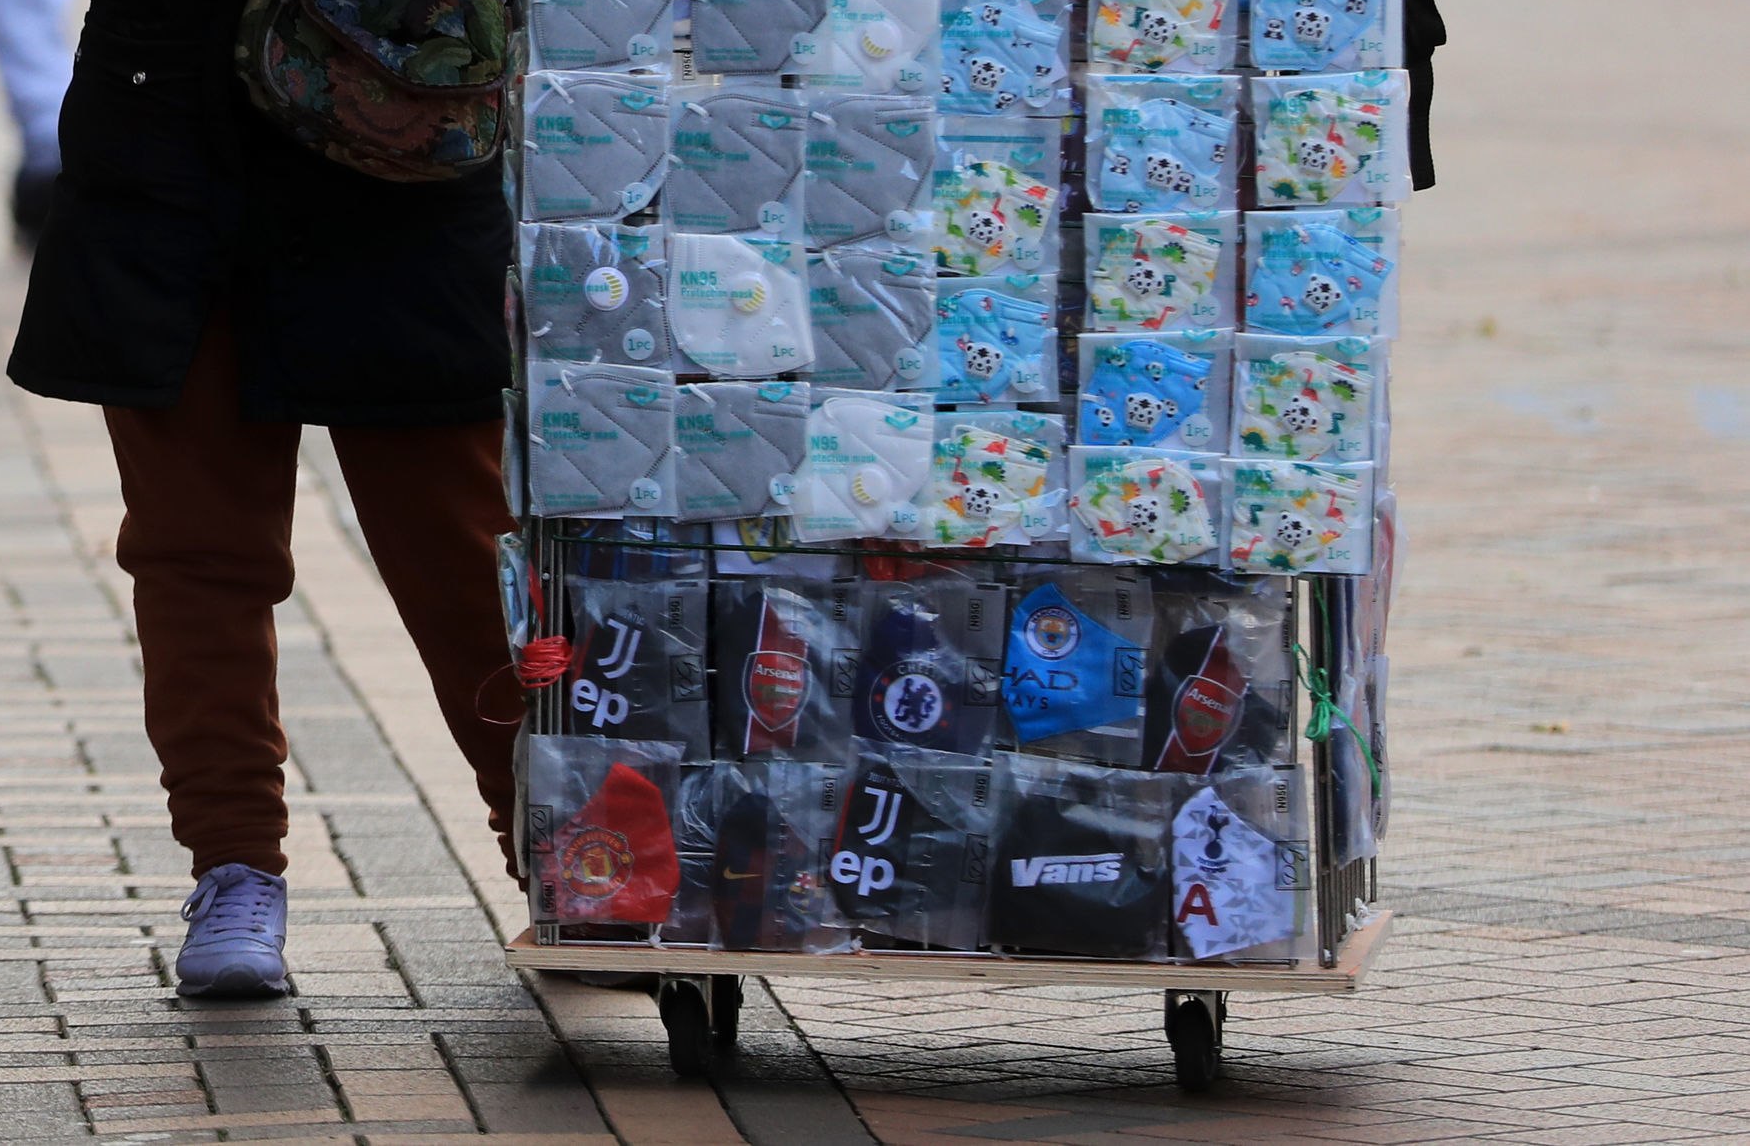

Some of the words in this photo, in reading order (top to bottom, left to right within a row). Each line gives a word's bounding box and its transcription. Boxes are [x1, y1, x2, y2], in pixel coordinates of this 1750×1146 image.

[536, 115, 574, 131] KN95
[680, 271, 717, 286] KN95
[542, 412, 580, 428] KN95
[677, 414, 715, 430] KN95
[811, 436, 838, 451] N95
[811, 454, 849, 463] otection
[754, 664, 801, 681] Arsenal
[1177, 883, 1219, 926] A
